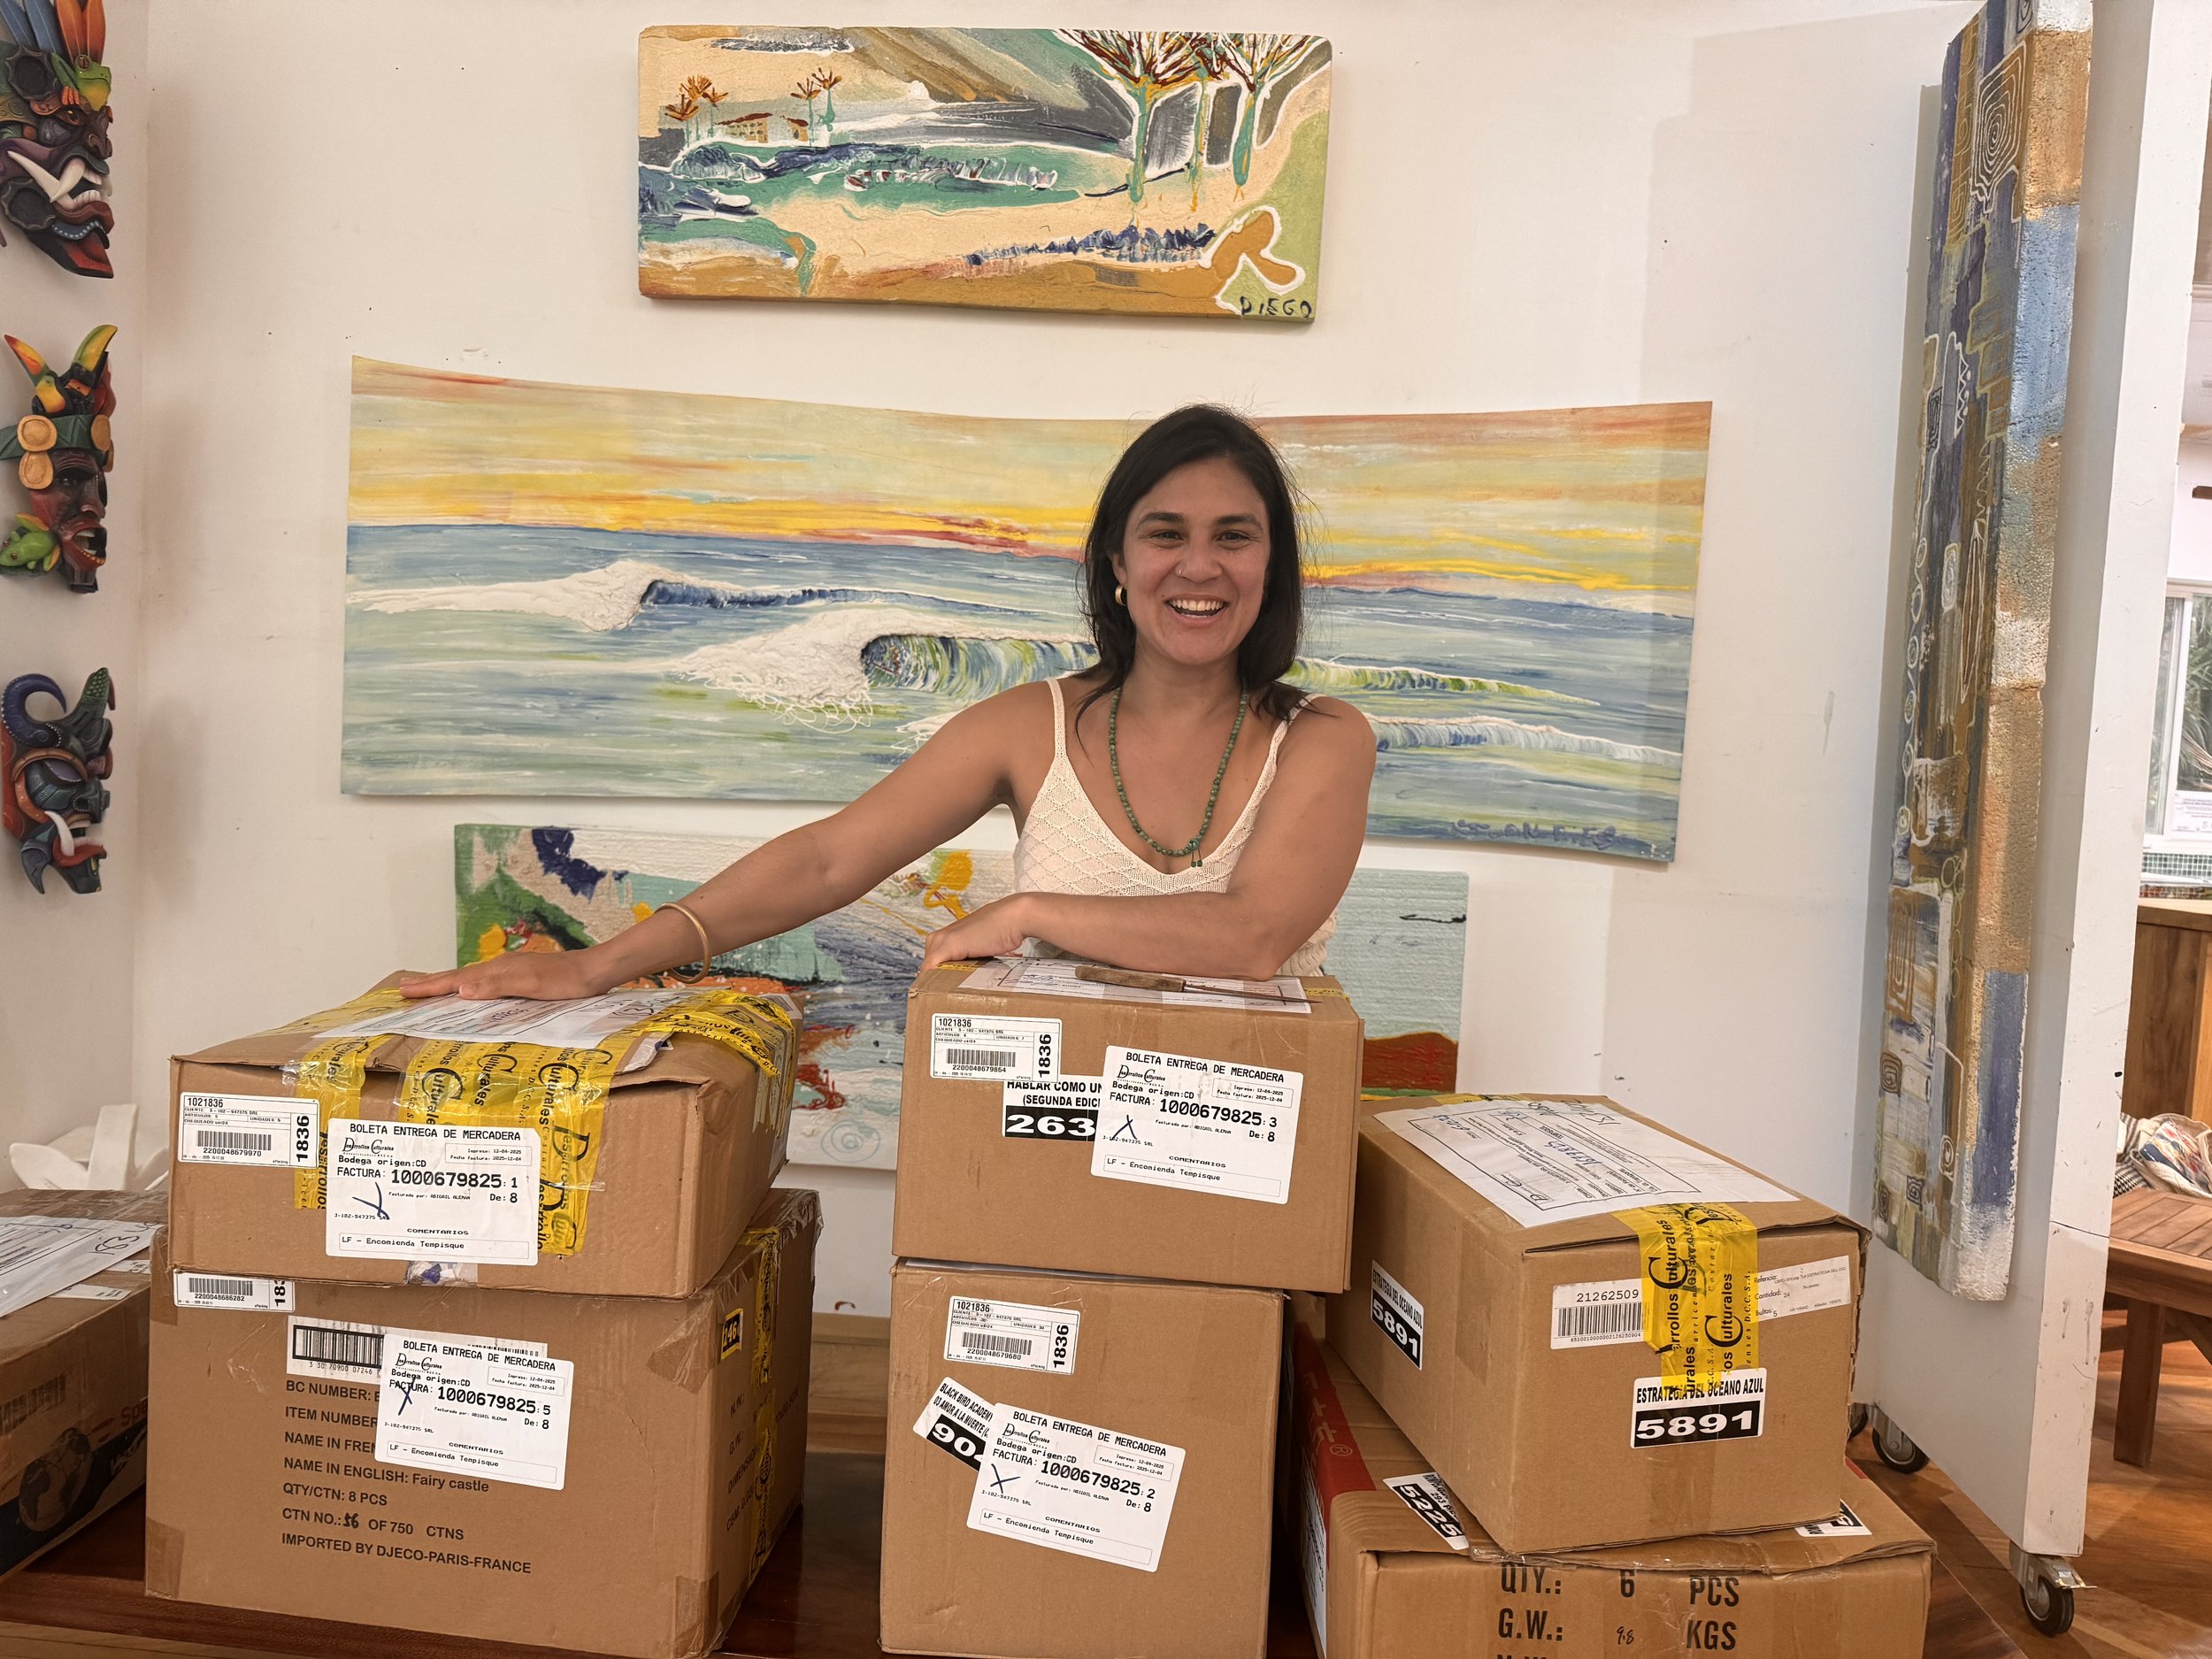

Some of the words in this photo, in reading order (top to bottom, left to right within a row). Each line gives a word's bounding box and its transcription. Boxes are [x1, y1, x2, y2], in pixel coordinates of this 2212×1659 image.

[1240, 296, 1312, 319] DIEGO
[939, 1018, 972, 1027] 1021836
[1038, 1034, 1051, 1078] 1836
[1125, 1052, 1161, 1065] BOLETA
[1167, 1057, 1208, 1071] ENTREGA
[1213, 1064, 1225, 1074] DE
[1231, 1067, 1284, 1083] MERCADERA
[1054, 1081, 1087, 1093] COMO
[1112, 1080, 1143, 1093] Bodega
[188, 1098, 223, 1108] 1021836
[1023, 1094, 1072, 1107] (SEGUNDA
[1110, 1092, 1155, 1106] FACTURA:
[1269, 1117, 1277, 1127] 3
[296, 1116, 310, 1163] 1836
[350, 1123, 388, 1134] BOLETA
[394, 1125, 438, 1137] ENTREGA
[443, 1129, 457, 1139] DE
[463, 1130, 520, 1141] MERCADERA
[1248, 1130, 1263, 1139] De:
[1267, 1132, 1275, 1141] 8
[203, 1147, 262, 1157] 2200048679970
[339, 1155, 372, 1165] Bodega
[1169, 1156, 1226, 1168] COMENTARIOS
[337, 1167, 386, 1178] FACTURA:
[511, 1177, 518, 1188] 1
[1129, 1162, 1175, 1174] Encomienda
[1180, 1169, 1220, 1180] Tempisque
[489, 1193, 506, 1202] De:
[510, 1192, 518, 1203] 8
[366, 1237, 415, 1247] Encomienda
[1647, 1219, 1688, 1289] Culturales
[1577, 1289, 1639, 1302] 21262509
[1755, 1289, 1782, 1300] Cantidad:
[956, 1301, 990, 1312] 1021836
[1704, 1273, 1744, 1348] Culturales
[1373, 1298, 1417, 1358] 5891
[1413, 1308, 1422, 1329] AZUL
[403, 1340, 438, 1353] BOLETA
[442, 1346, 482, 1360] ENTREGA
[488, 1353, 499, 1363] DE
[504, 1356, 556, 1371] MERCADERA
[967, 1348, 1022, 1361] 2200048679680
[1053, 1325, 1069, 1368] 1836
[352, 1366, 373, 1375] 07246
[391, 1368, 421, 1380] Bodega
[286, 1379, 305, 1393] BC
[309, 1382, 372, 1401] NUMBER:
[389, 1379, 434, 1394] FACTURA:
[542, 1404, 550, 1416] 5
[940, 1383, 959, 1400] BLACK
[956, 1394, 971, 1408] BIRD
[1637, 1385, 1687, 1403] ESTRATEGIA
[1742, 1378, 1763, 1394] AZUL
[285, 1406, 308, 1421] ITEM
[524, 1417, 539, 1426] De:
[541, 1419, 549, 1429] 8
[933, 1395, 942, 1406] 03
[939, 1400, 956, 1415] AMOR
[952, 1408, 960, 1417] A
[956, 1410, 966, 1422] LA
[964, 1414, 986, 1433] MUERTE
[1013, 1410, 1048, 1427] BOLETA
[1052, 1420, 1093, 1438] ENTREGA
[1097, 1432, 1111, 1442] DE
[1115, 1436, 1167, 1456] MERCADERA
[1636, 1410, 1753, 1440] 5891
[284, 1431, 324, 1447] NAME
[327, 1437, 341, 1449] IN
[449, 1441, 504, 1455] COMENTARIOS
[996, 1438, 1027, 1452] Bodega
[411, 1448, 456, 1460] Encomienda
[459, 1455, 499, 1467] Tempisque
[283, 1456, 323, 1472] NAME
[326, 1463, 340, 1475] IN
[343, 1464, 409, 1484] ENGLISH:
[412, 1473, 446, 1490] Fairy
[449, 1479, 489, 1492] castle
[993, 1448, 1038, 1466] FACTURA:
[1147, 1488, 1156, 1499] 2
[1136, 1465, 1163, 1476] 2025-12-04
[282, 1482, 345, 1502] QTY/CTN:
[349, 1491, 357, 1502] 8
[360, 1493, 388, 1506] PCS
[1125, 1499, 1141, 1509] De:
[1143, 1502, 1152, 1512] 8
[1400, 1486, 1463, 1536] 5225
[282, 1508, 310, 1522] CTN
[368, 1518, 388, 1531] OF
[390, 1522, 413, 1534] 750
[426, 1525, 464, 1540] CTNS
[1005, 1517, 1050, 1534] Encomienda
[1055, 1529, 1094, 1545] Tempisque
[1045, 1516, 1101, 1533] COMENTARIOS
[282, 1532, 352, 1552] IMPORTED
[356, 1542, 373, 1555] BY
[377, 1545, 532, 1574] DJECO-PARIS-FRANCE
[1619, 1570, 1635, 1598] 6
[1689, 1575, 1740, 1607] PCS
[1498, 1608, 1563, 1641] G.W.:
[1686, 1620, 1737, 1650] KGS
